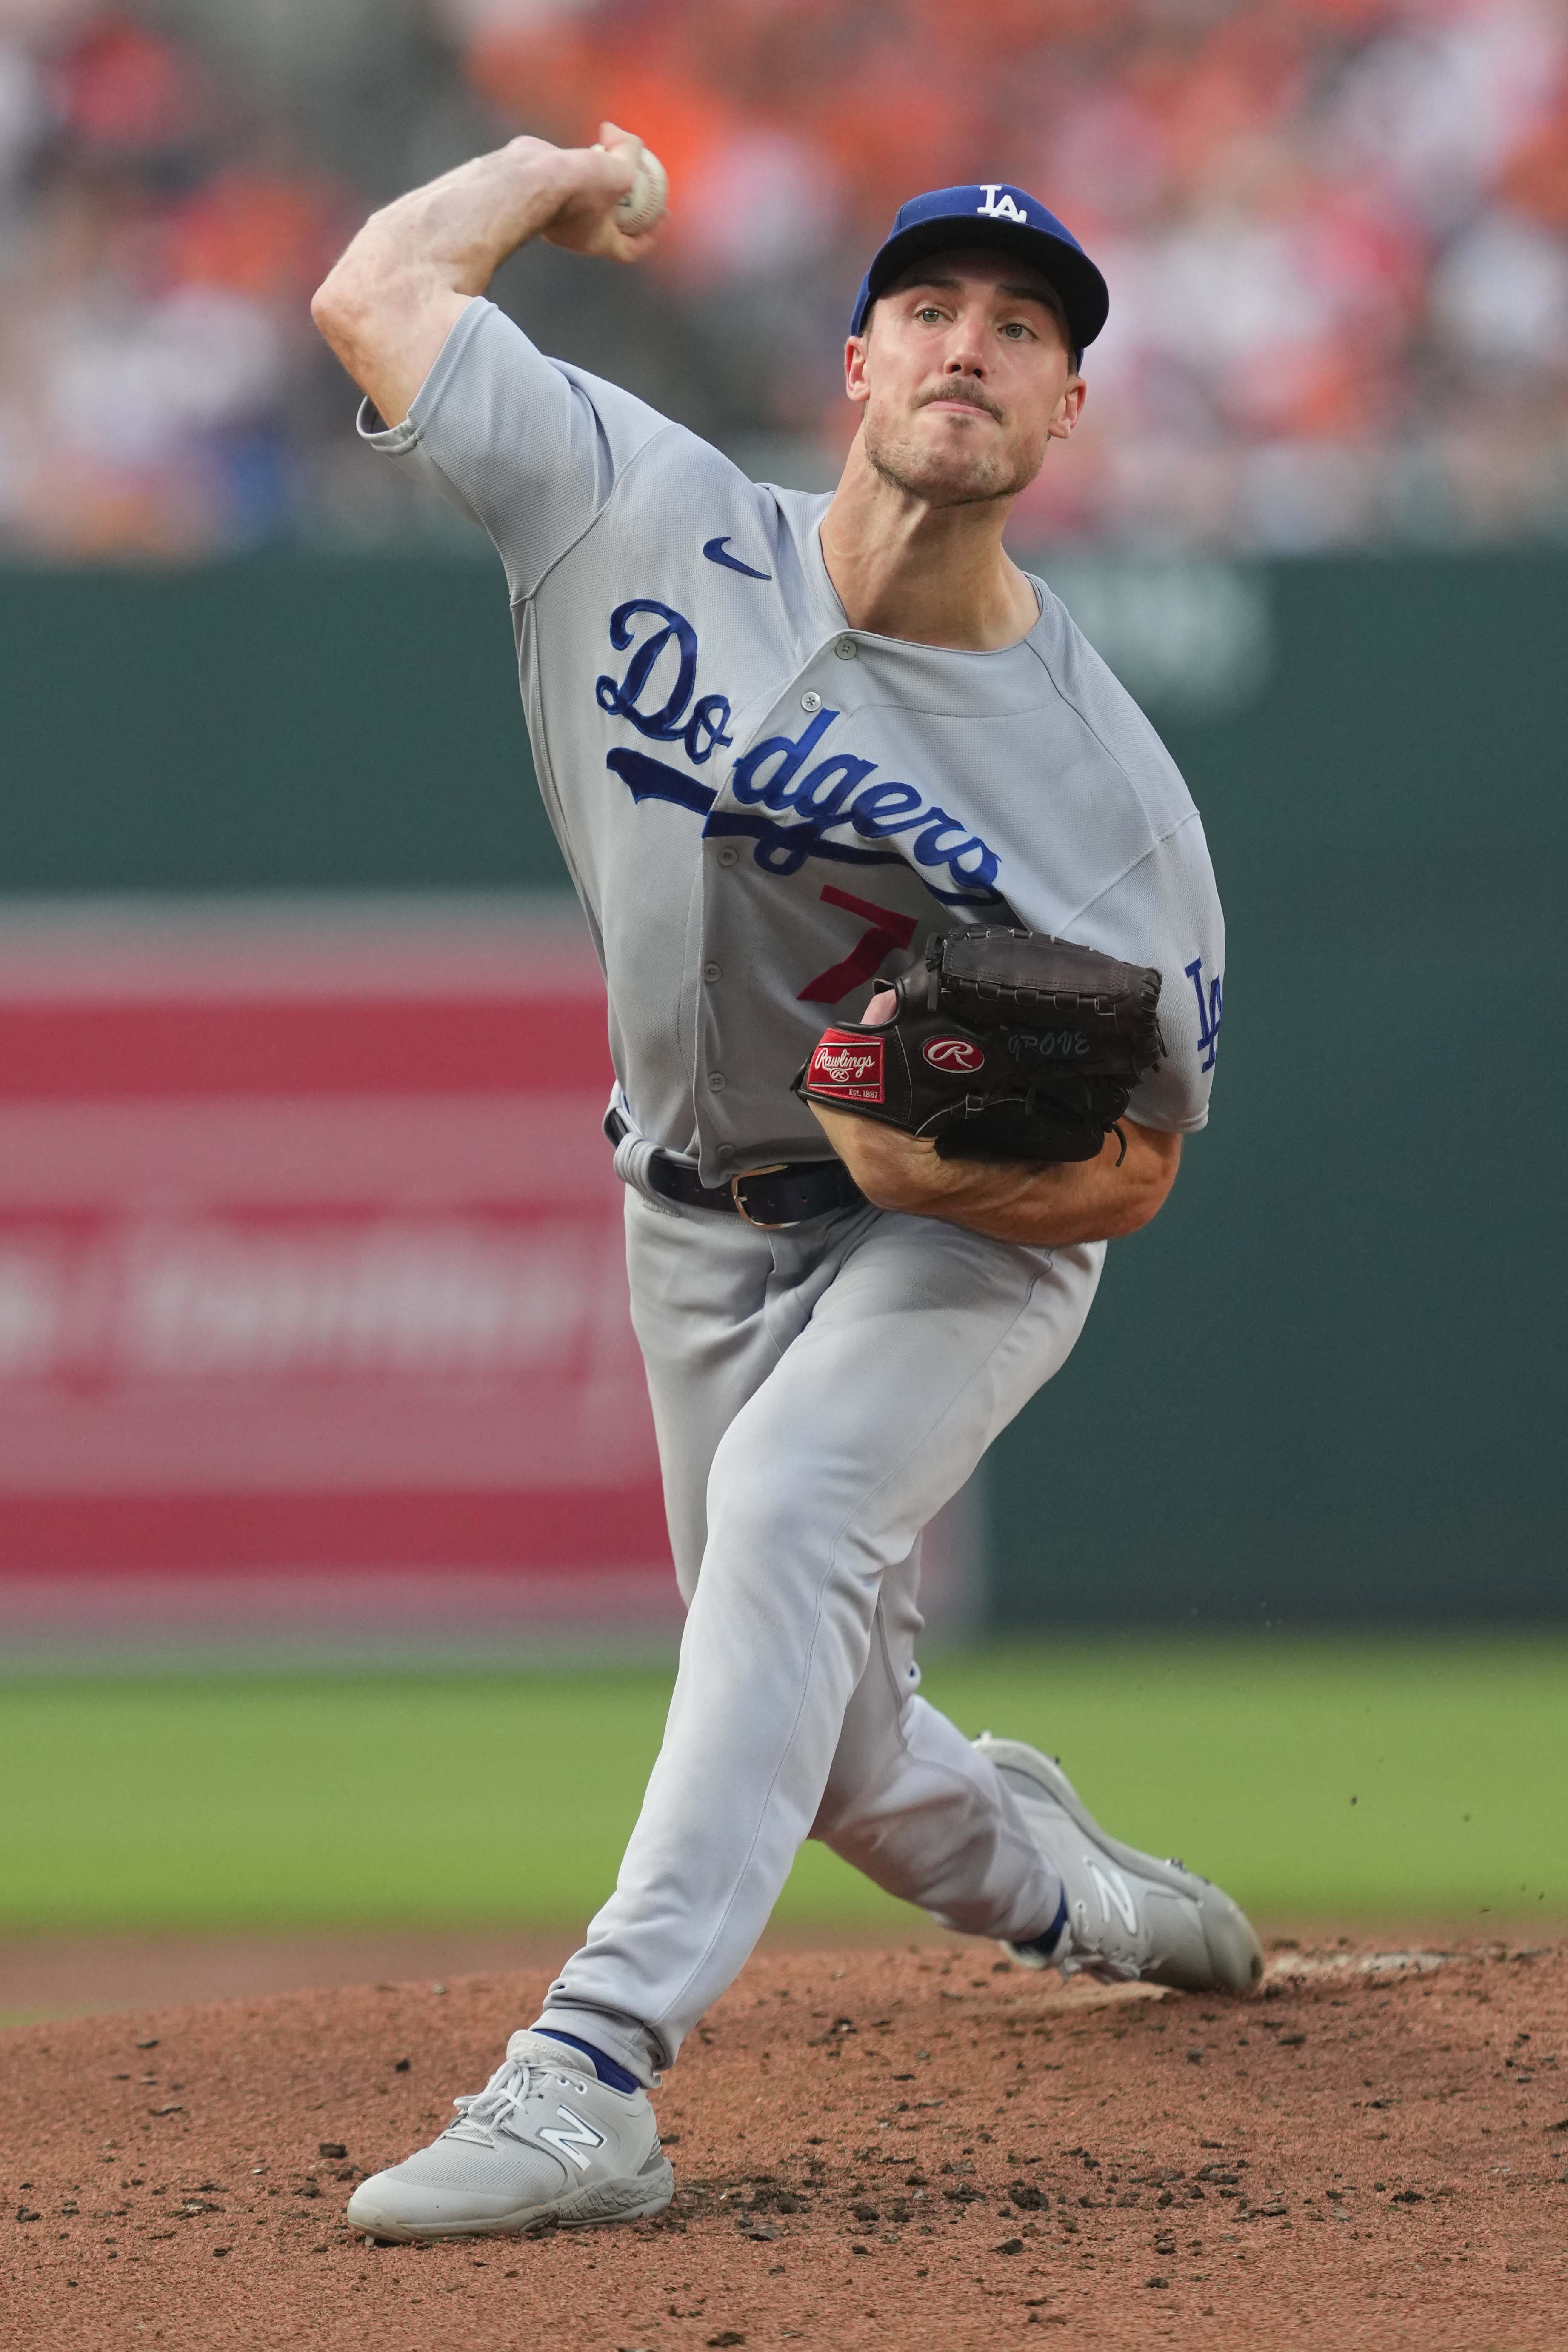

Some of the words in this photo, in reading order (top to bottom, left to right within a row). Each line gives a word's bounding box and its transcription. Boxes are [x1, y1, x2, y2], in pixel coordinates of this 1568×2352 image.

[977, 185, 1027, 223] LA
[596, 598, 1002, 889] Dodgers
[1008, 1031, 1090, 1061] GROVE
[814, 1047, 875, 1078] Rawlings
[848, 1089, 861, 1097] Est.
[863, 1090, 878, 1099] 1887
[512, 2041, 531, 2049] new
